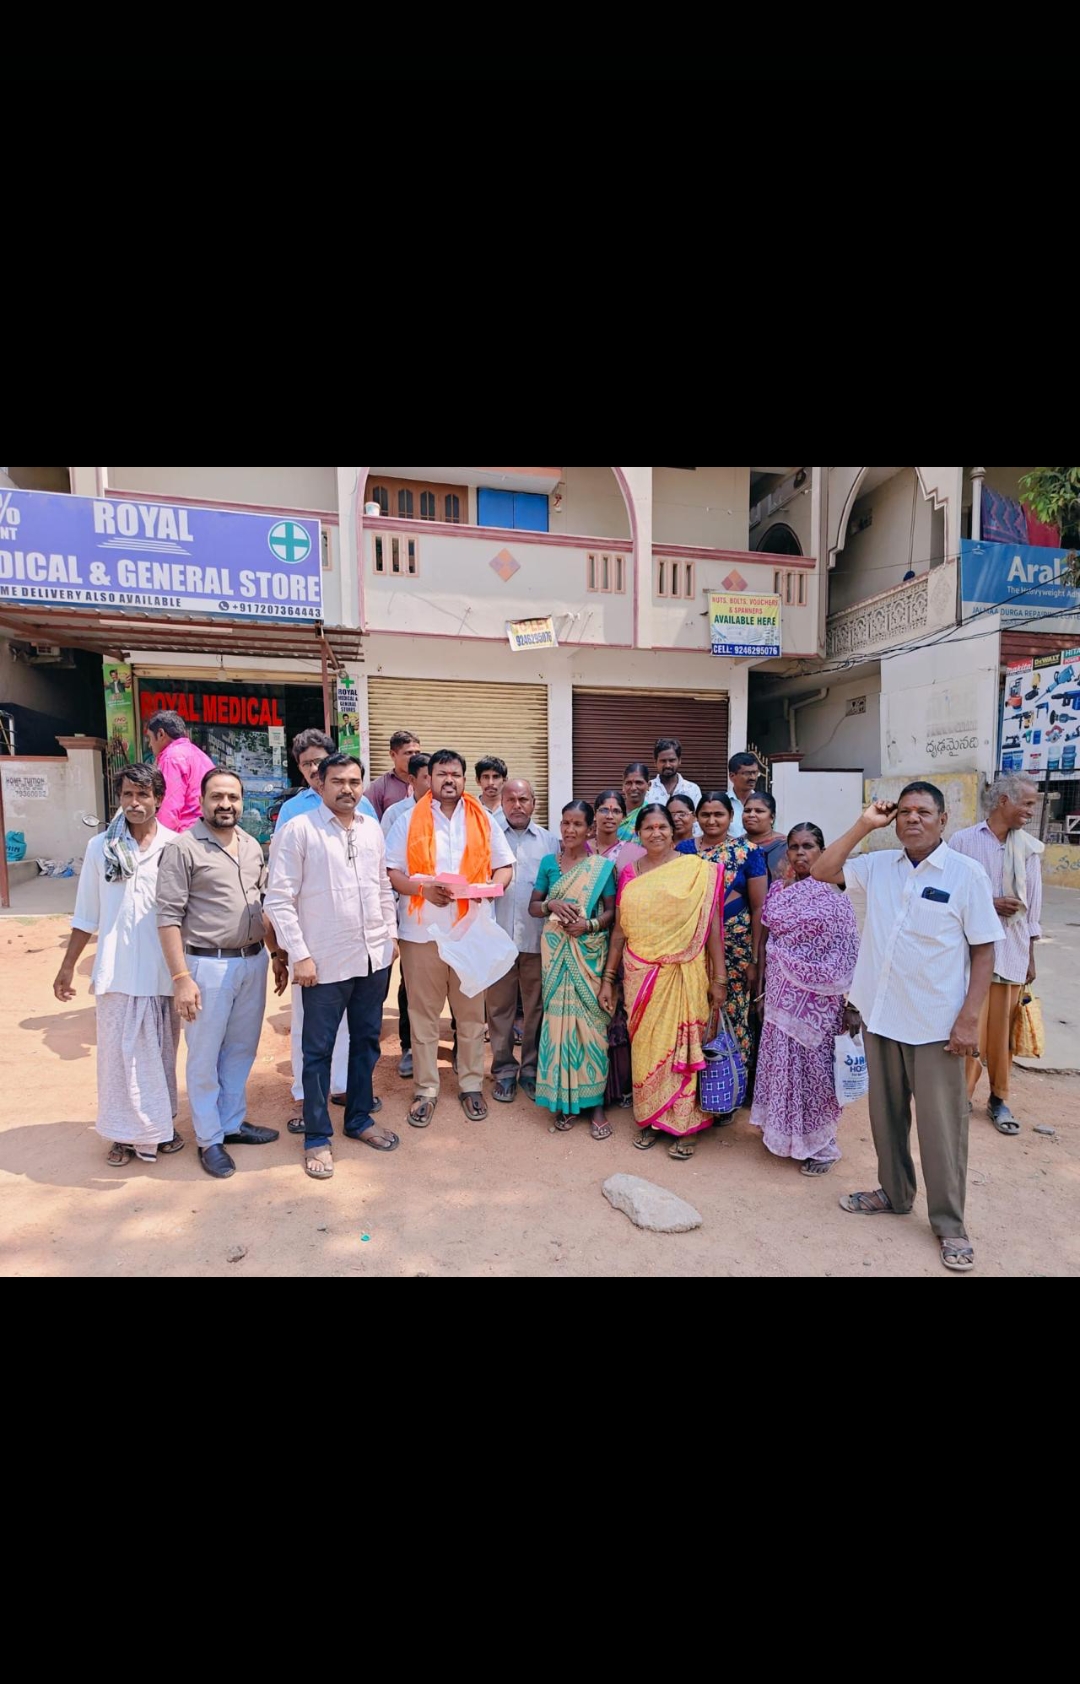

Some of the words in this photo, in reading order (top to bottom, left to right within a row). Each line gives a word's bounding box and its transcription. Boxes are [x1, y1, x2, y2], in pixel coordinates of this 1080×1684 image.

[93, 501, 194, 541] ROYAL
[89, 561, 111, 586] &
[117, 559, 234, 596] GENERAL
[239, 569, 321, 602] STORE
[1007, 585, 1020, 594] The
[21, 587, 82, 600] DELIVERY
[85, 591, 116, 603] ALSO
[119, 593, 181, 607] AVAILABLE
[734, 607, 763, 615] SPANNERS
[1000, 608, 1023, 617] DURGA
[714, 614, 755, 626] AVAILABLE
[756, 616, 777, 626] HERE
[713, 644, 733, 655] CELL:
[734, 645, 778, 656] 9246295076
[337, 688, 358, 696] ROYAL
[140, 692, 199, 722] ROYAL
[202, 694, 282, 726] MEDICAL
